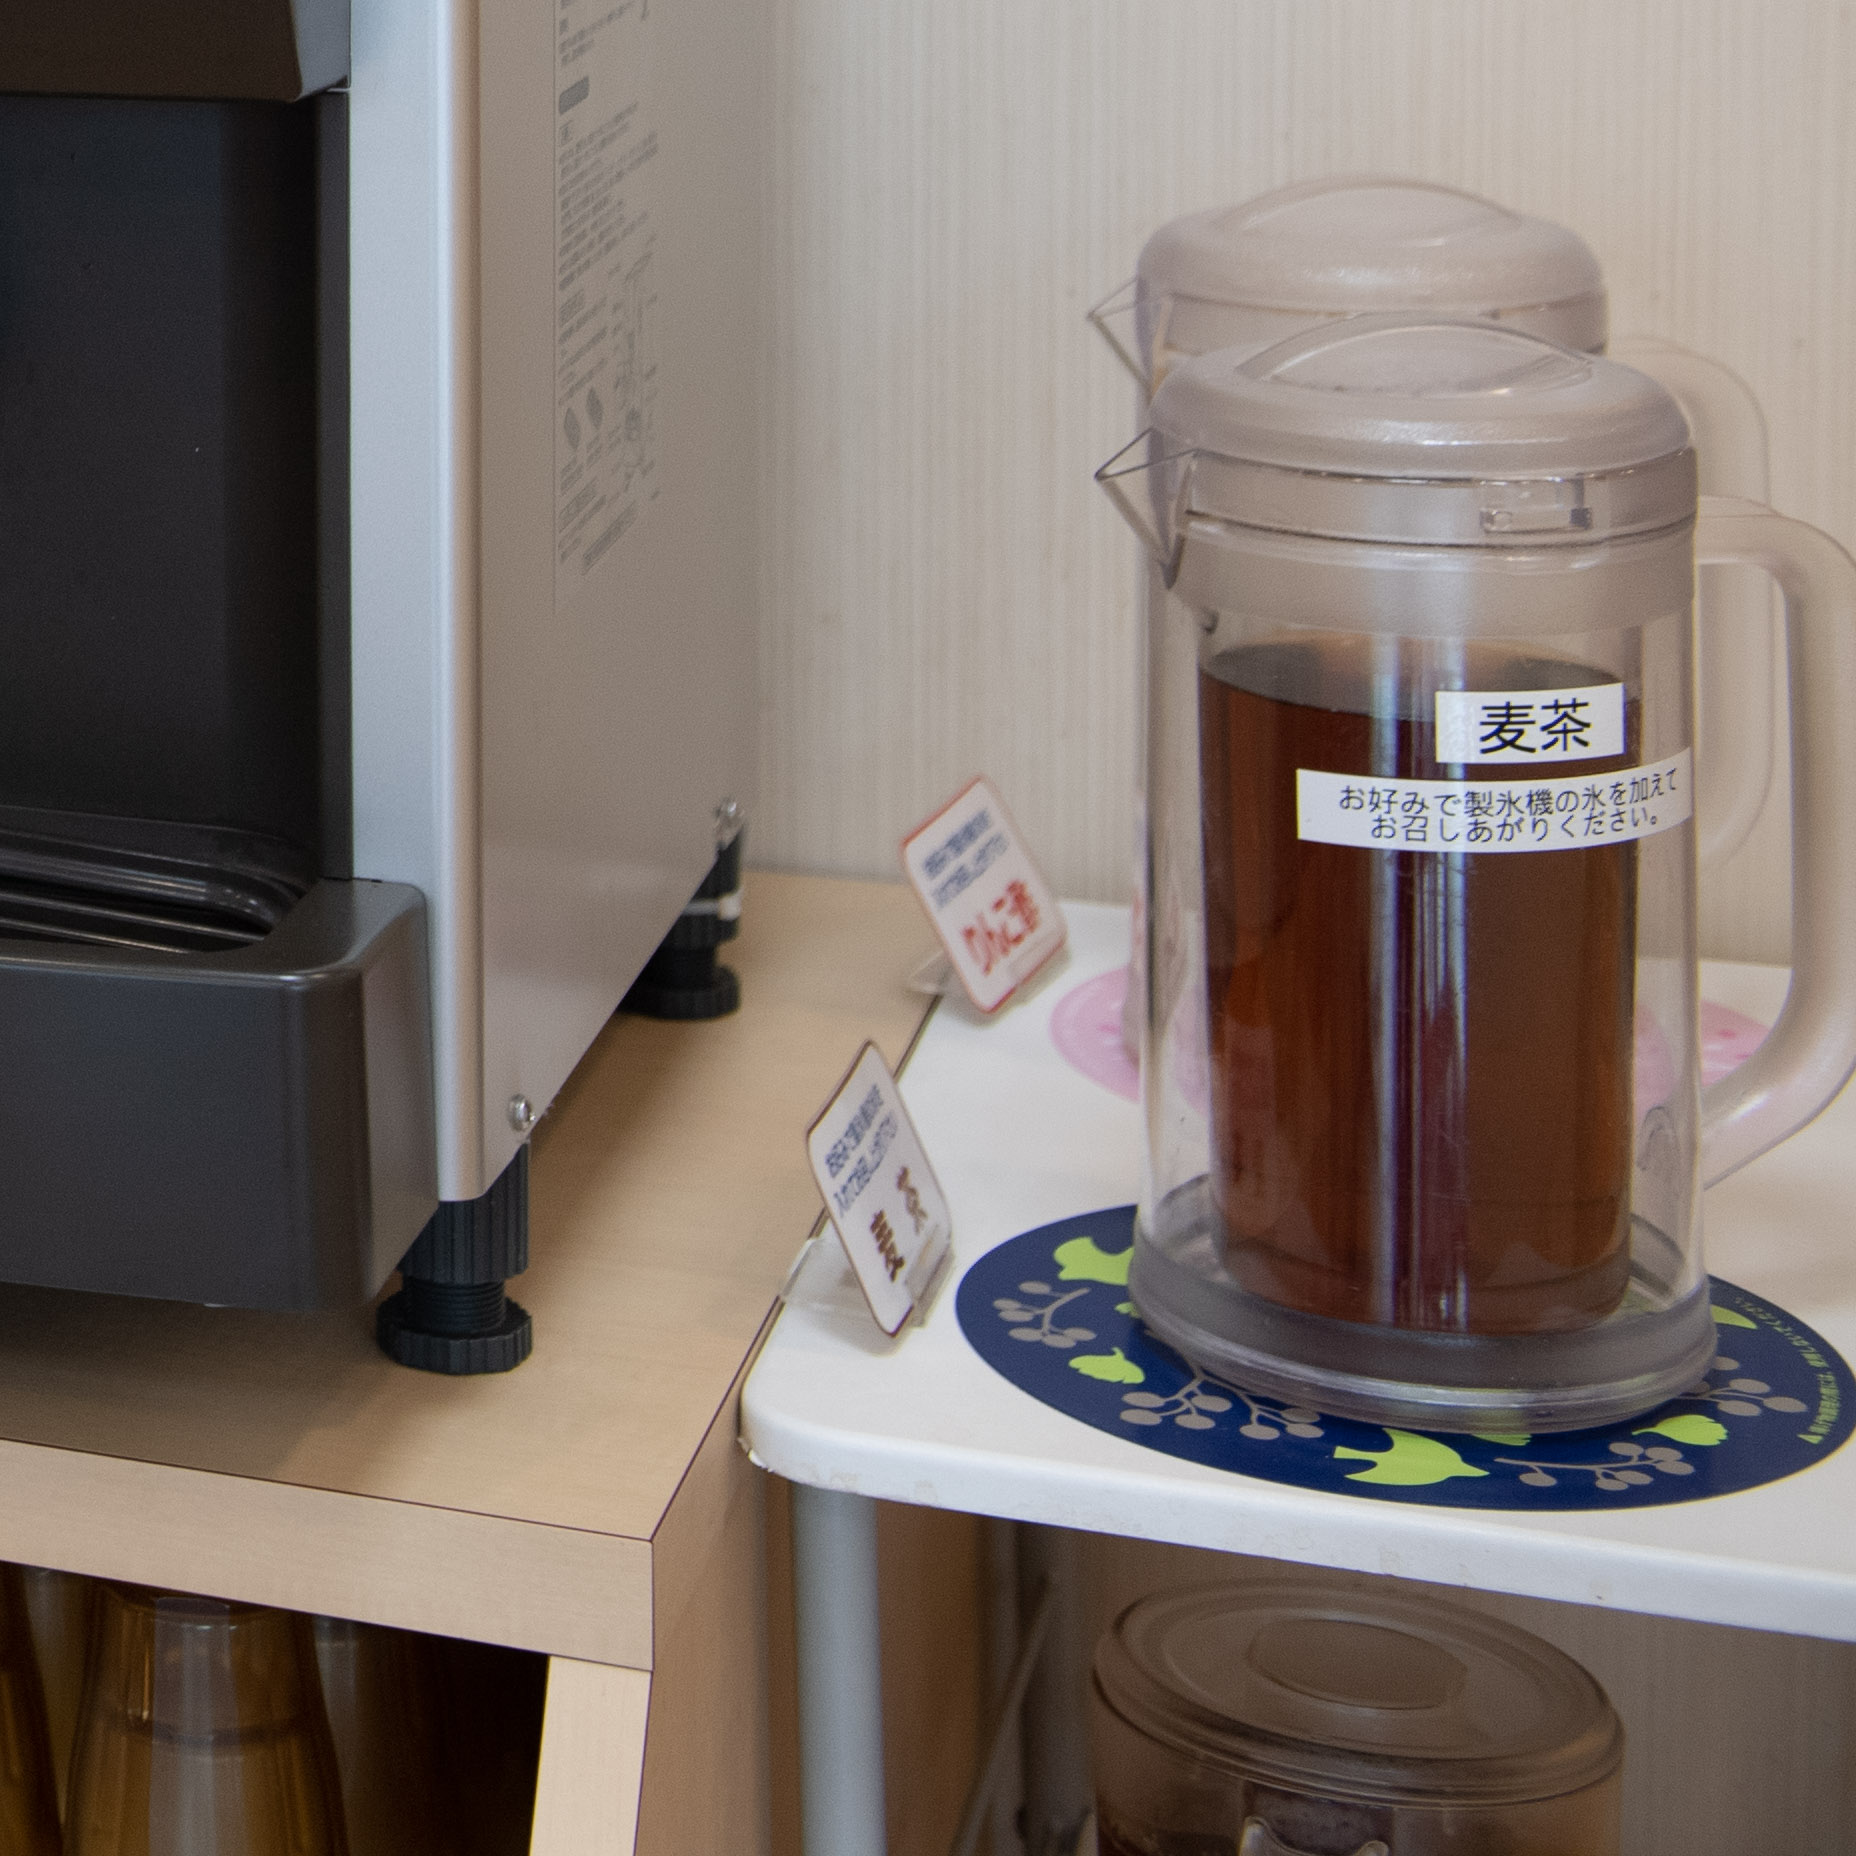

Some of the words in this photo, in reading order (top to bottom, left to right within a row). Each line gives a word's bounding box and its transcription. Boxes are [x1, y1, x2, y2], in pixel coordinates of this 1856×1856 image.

[1479, 697, 1592, 755] 麦茶
[1338, 768, 1678, 818] お好みで製氷機の氷を加えて
[1370, 807, 1660, 844] お召しあがりください。
